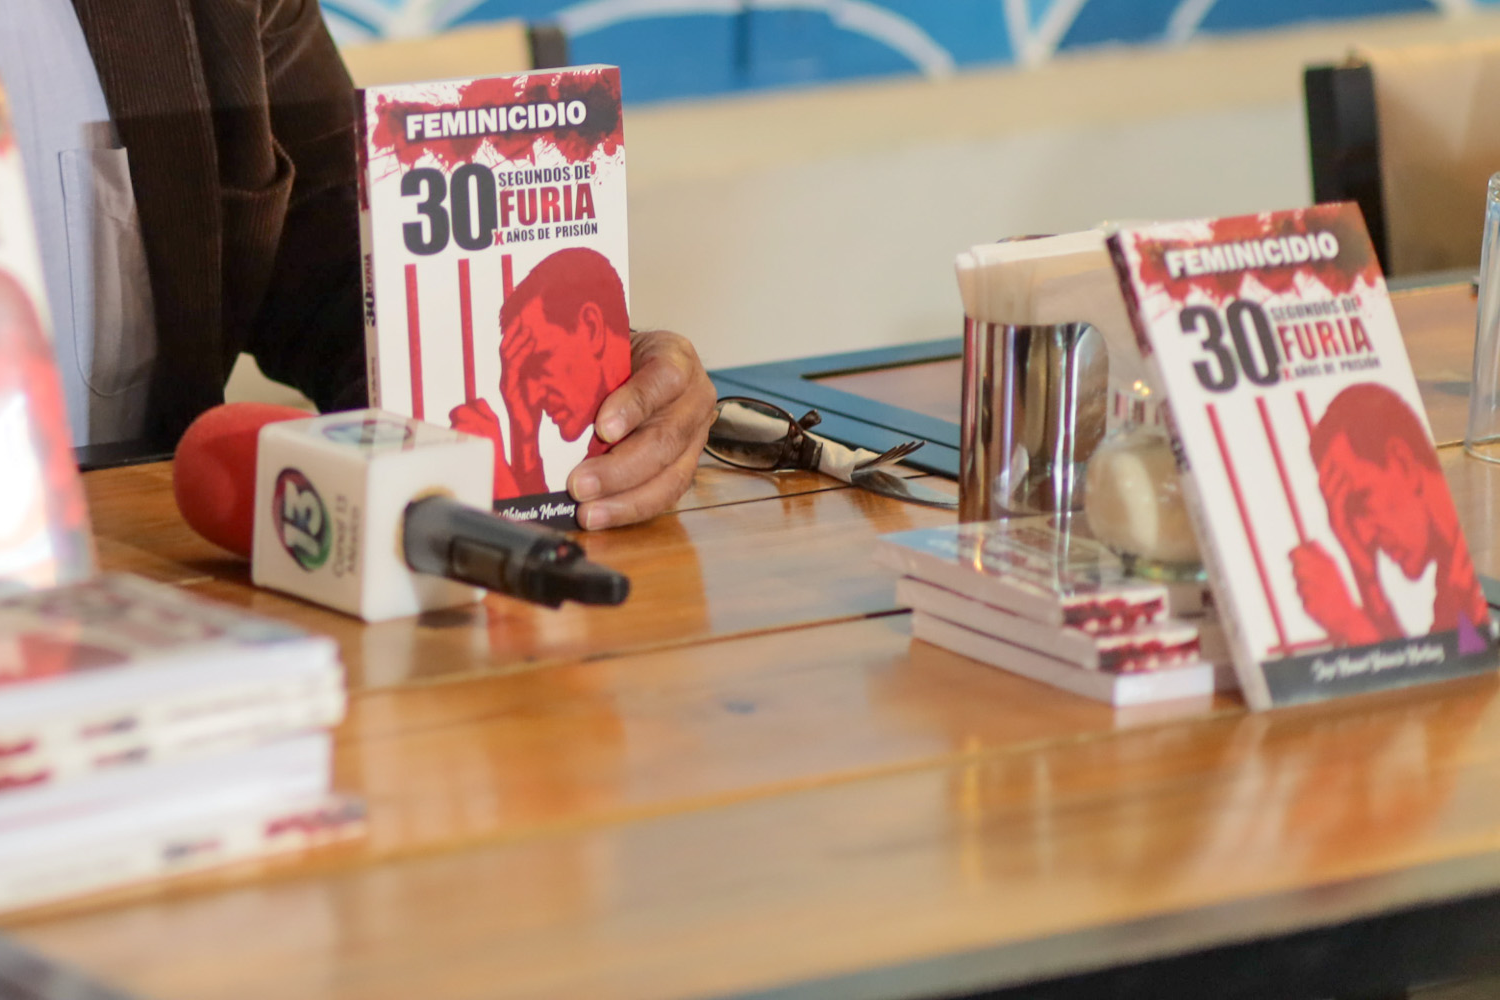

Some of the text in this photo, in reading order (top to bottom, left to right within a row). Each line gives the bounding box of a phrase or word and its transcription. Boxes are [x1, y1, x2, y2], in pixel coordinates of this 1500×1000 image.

[406, 100, 587, 140] FEMINICIDIO
[499, 165, 591, 187] SEGUNDOS DE
[400, 163, 498, 256] 30
[500, 183, 596, 228] FURIA
[506, 229, 535, 243] AÑOS
[538, 228, 550, 240] DE
[555, 221, 598, 239] PRISIÓN
[1165, 231, 1339, 278] FEMINICIDIO
[1270, 301, 1340, 321] SEGUNDOS
[1179, 300, 1281, 393] 30
[1277, 317, 1374, 362] FURIA
[283, 479, 322, 557] 13
